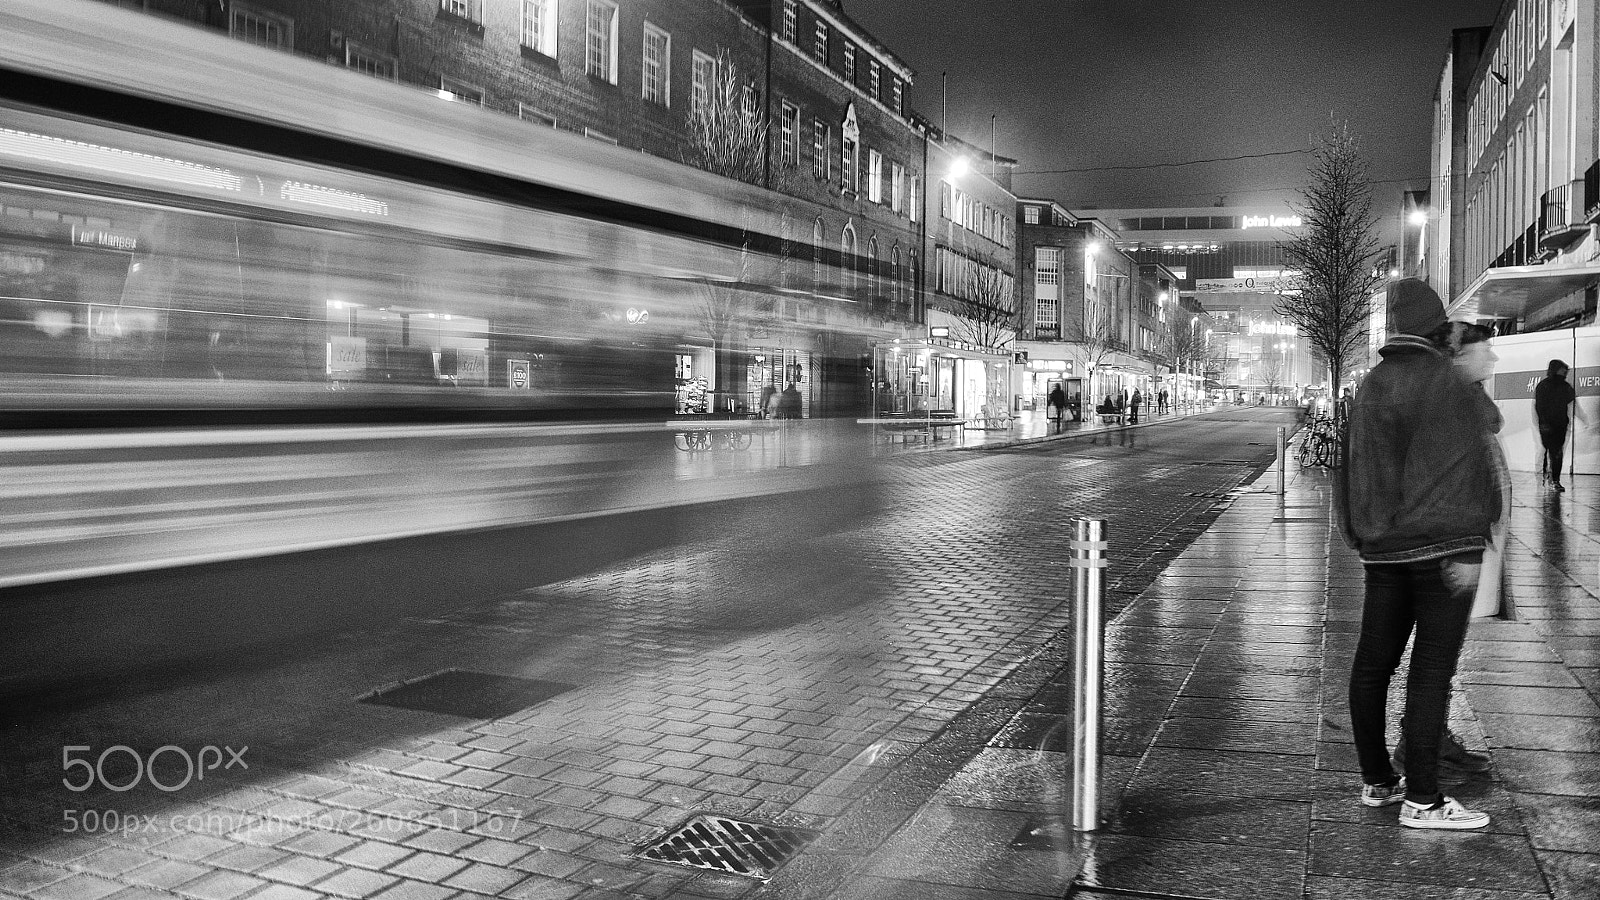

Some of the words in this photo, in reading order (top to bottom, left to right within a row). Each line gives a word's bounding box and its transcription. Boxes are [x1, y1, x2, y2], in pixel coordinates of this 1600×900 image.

[1242, 215, 1268, 230] John
[1269, 214, 1302, 227] Lewis
[1248, 320, 1276, 336] John
[337, 343, 361, 363] sale
[461, 355, 481, 373] sale
